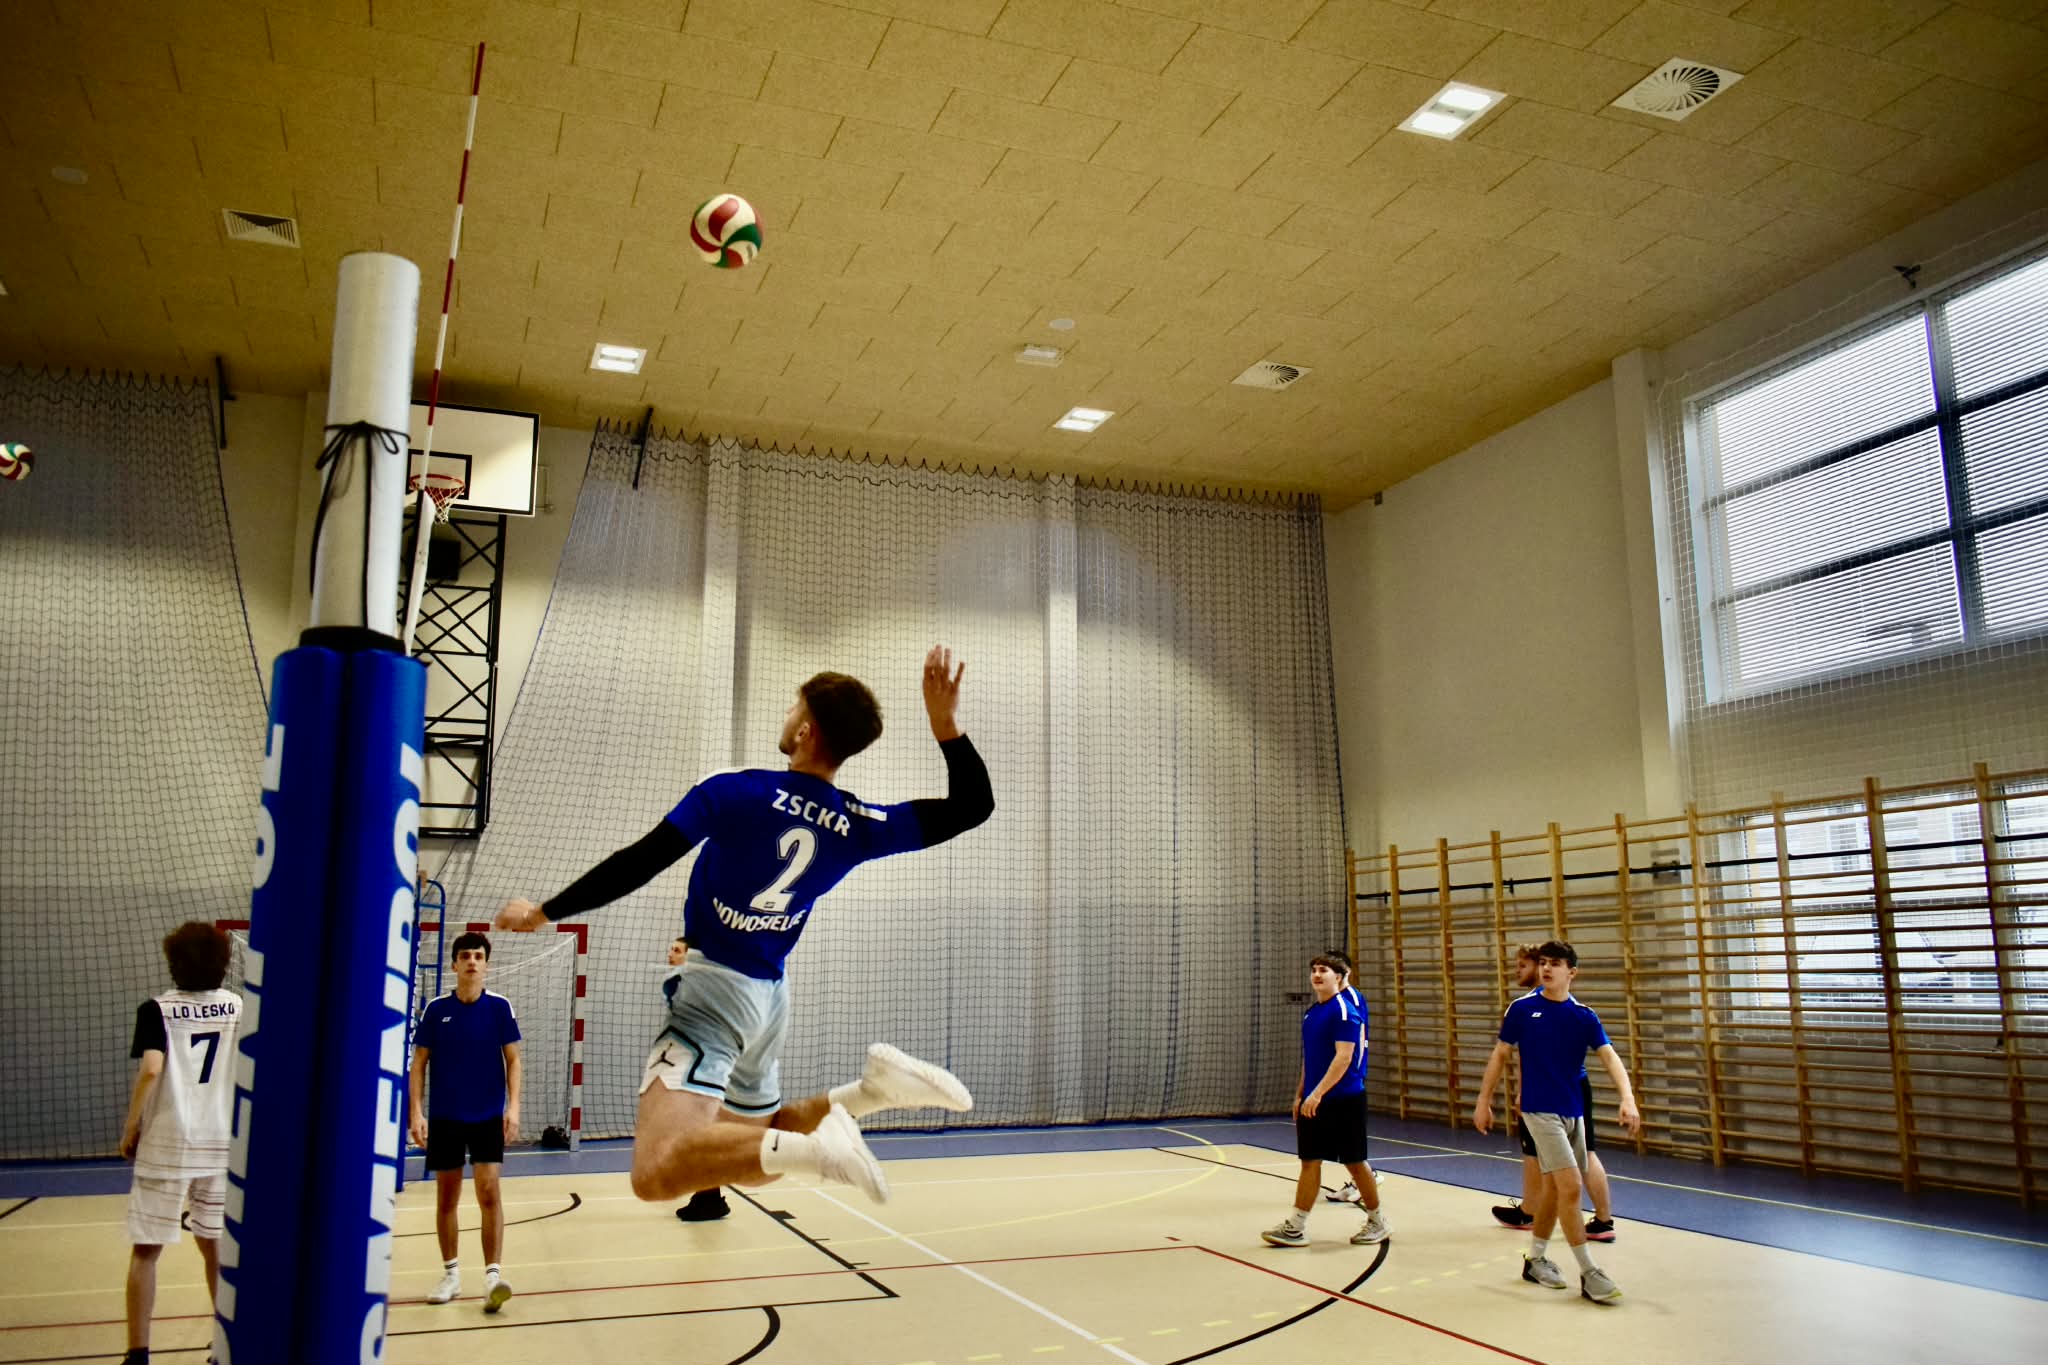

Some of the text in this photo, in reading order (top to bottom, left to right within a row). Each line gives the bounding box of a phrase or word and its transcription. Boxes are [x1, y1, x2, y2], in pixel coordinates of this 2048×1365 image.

[772, 788, 851, 837] ZSCKR
[750, 826, 818, 913] 2
[713, 897, 806, 932] NOWOSIELE
[173, 1003, 235, 1019] LO LESKO
[191, 1031, 220, 1084] 7
